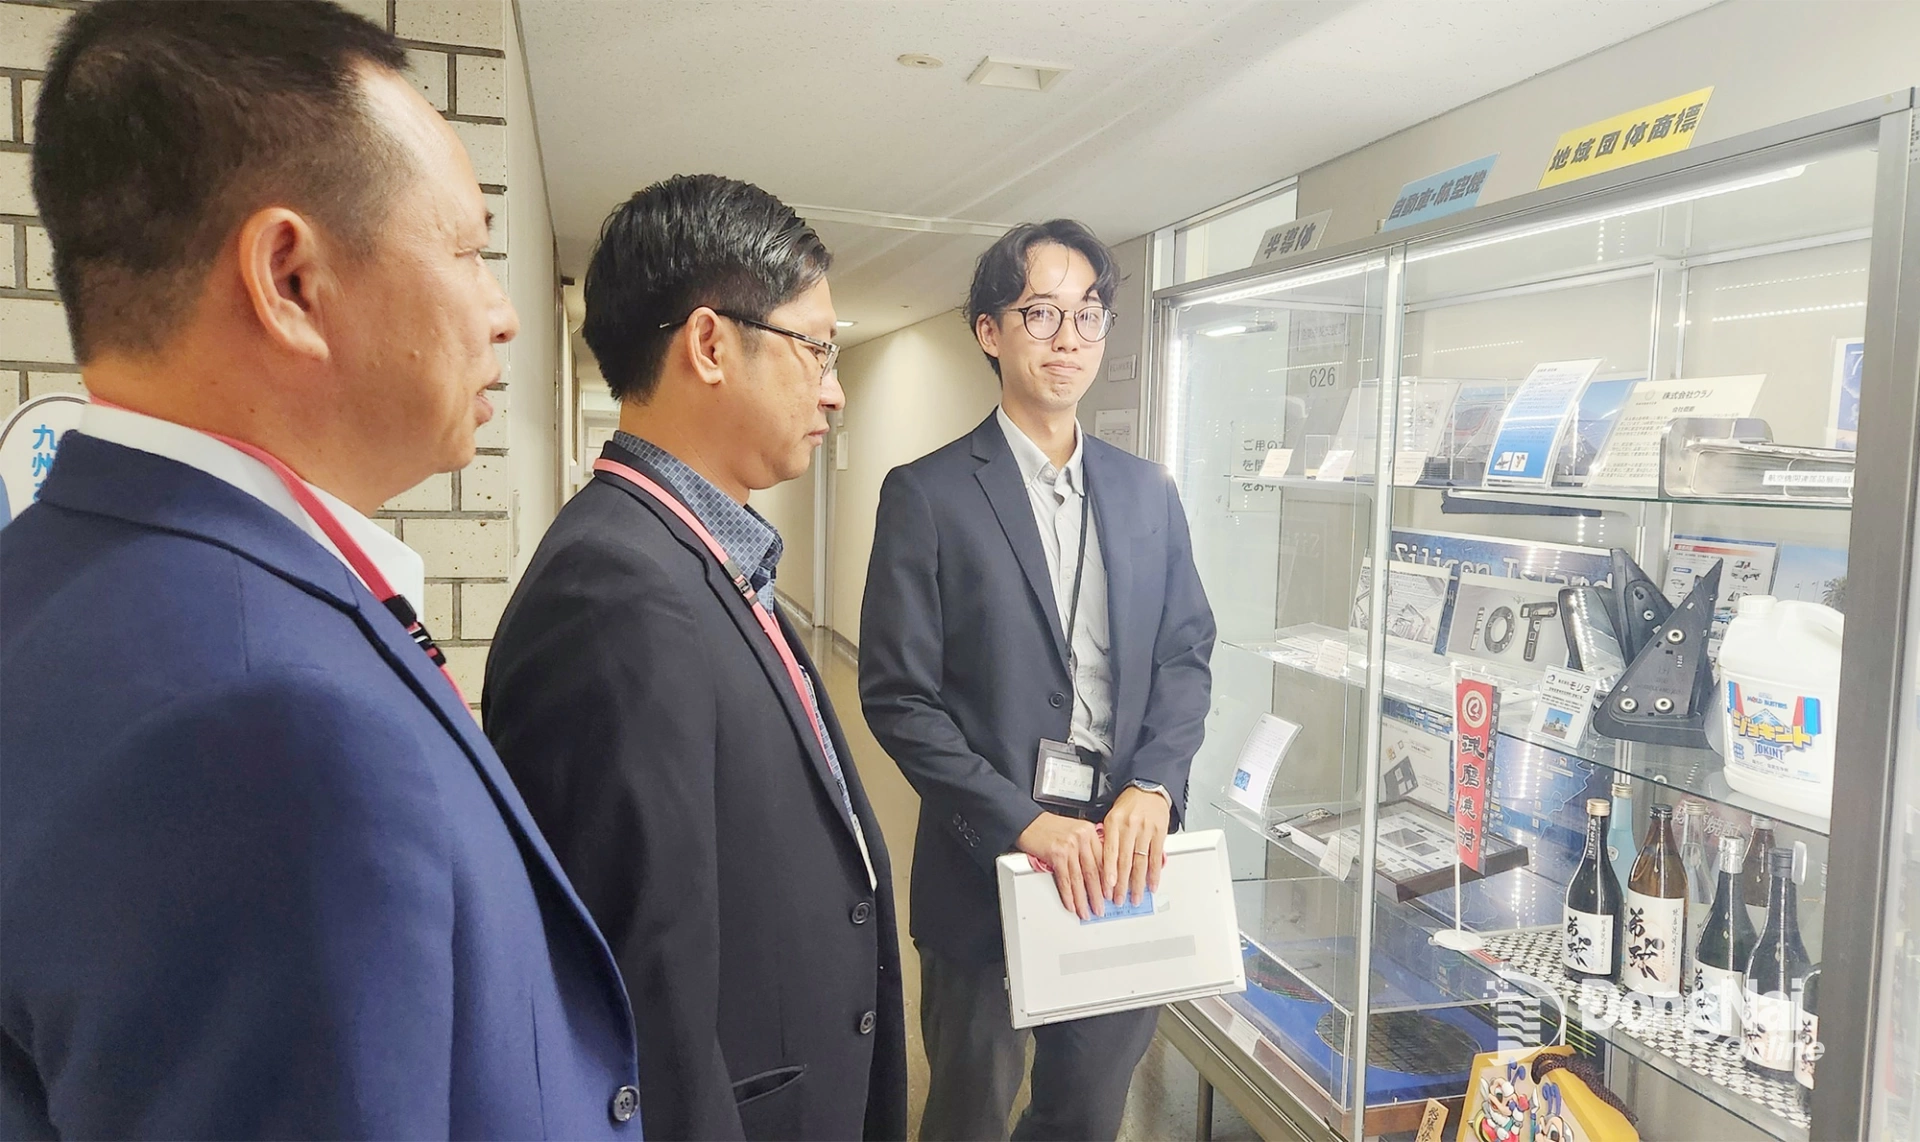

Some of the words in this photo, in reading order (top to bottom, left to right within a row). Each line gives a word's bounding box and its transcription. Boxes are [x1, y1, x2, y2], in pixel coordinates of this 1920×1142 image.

[1548, 101, 1704, 173] 地域団体商標
[1388, 169, 1488, 220] 自動車・航空機
[1263, 222, 1317, 260] 半導体
[1309, 366, 1335, 388] 626
[1662, 389, 1714, 401] 株式会社ウラノ
[1569, 681, 1591, 694] モリタ
[1732, 709, 1813, 752] ジョキント
[1754, 743, 1784, 761] JOKINT
